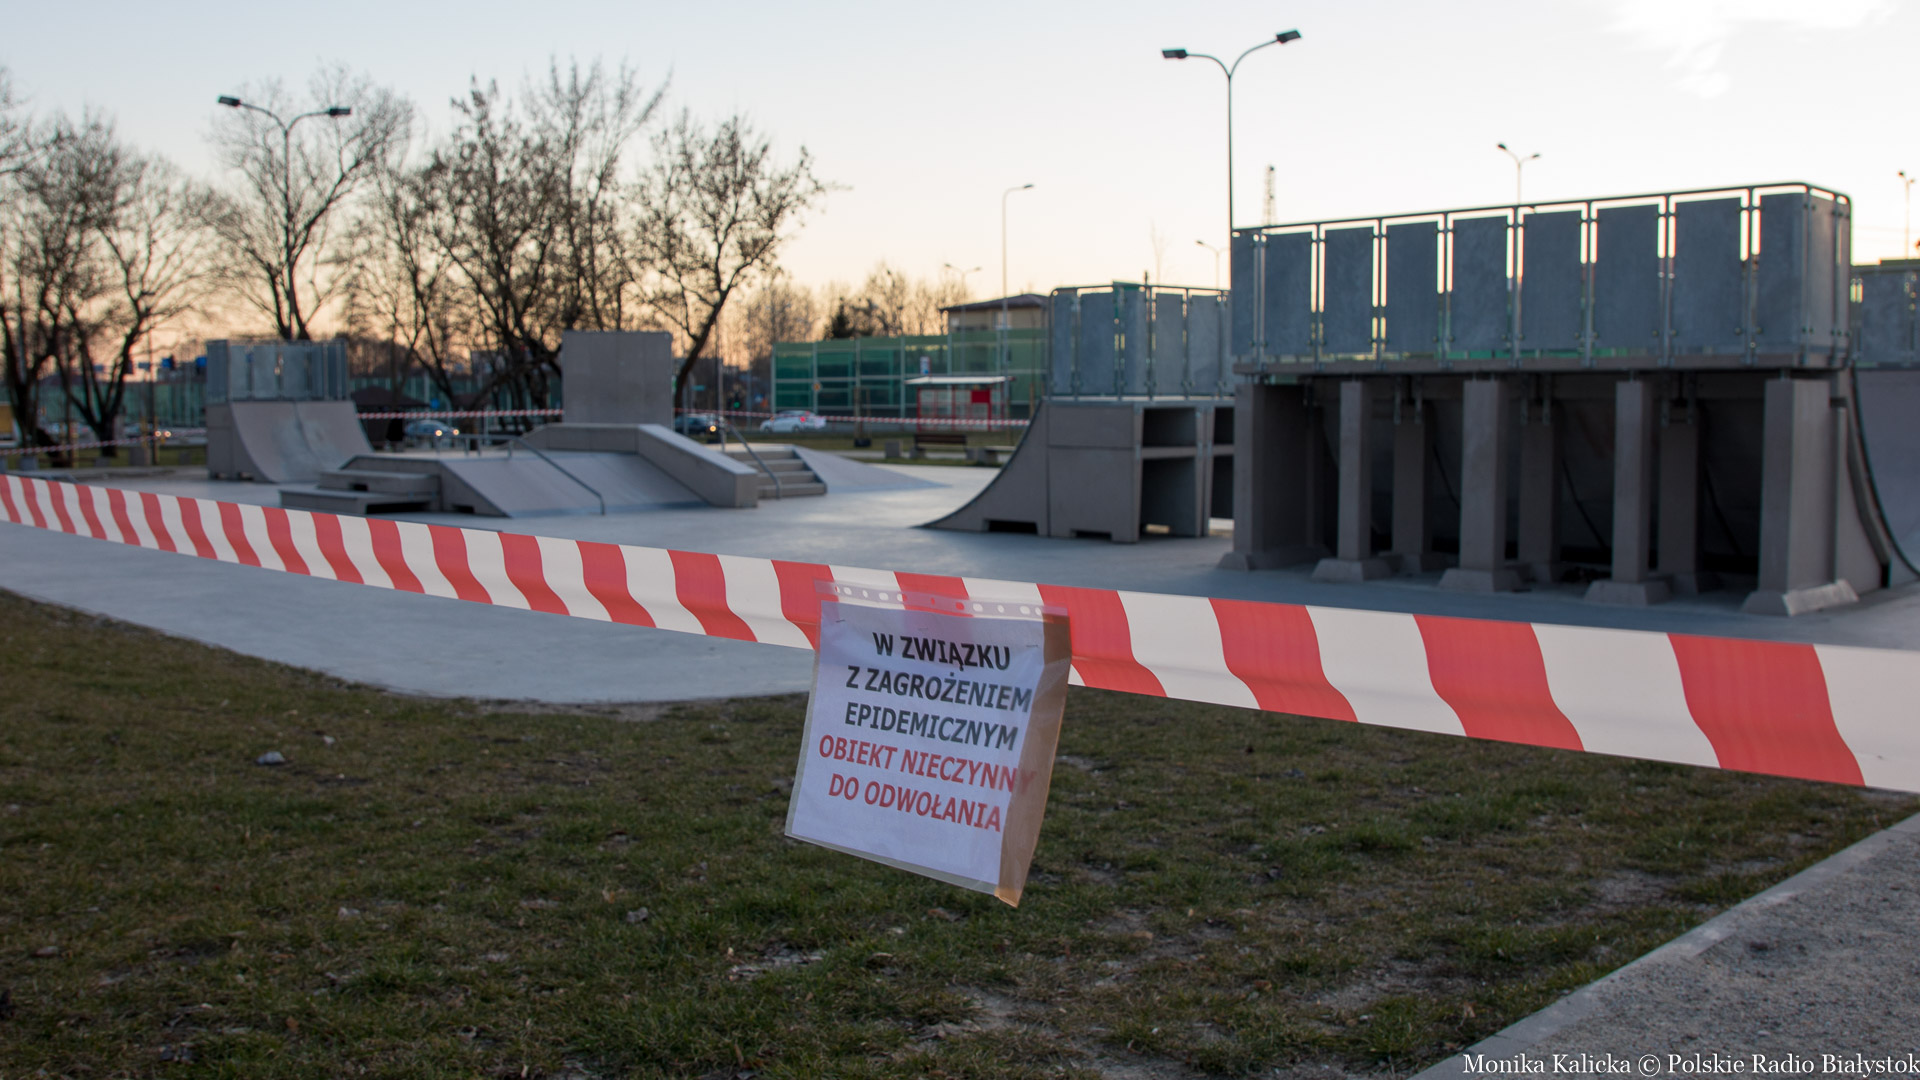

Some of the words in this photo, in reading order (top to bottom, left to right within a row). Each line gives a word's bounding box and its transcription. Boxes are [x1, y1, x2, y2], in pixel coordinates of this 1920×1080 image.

[872, 632, 894, 656] W
[900, 636, 1010, 671] ZWIĄZKU
[846, 665, 860, 689] Z
[865, 668, 1032, 713] ZAGROŻENIEM
[845, 702, 1018, 750] EPIDEMICZNYM
[819, 735, 898, 769] OBIEKT
[900, 750, 1037, 795] NIECZYNNY
[829, 773, 859, 800] DO
[864, 781, 1001, 832] ODWOŁANIA
